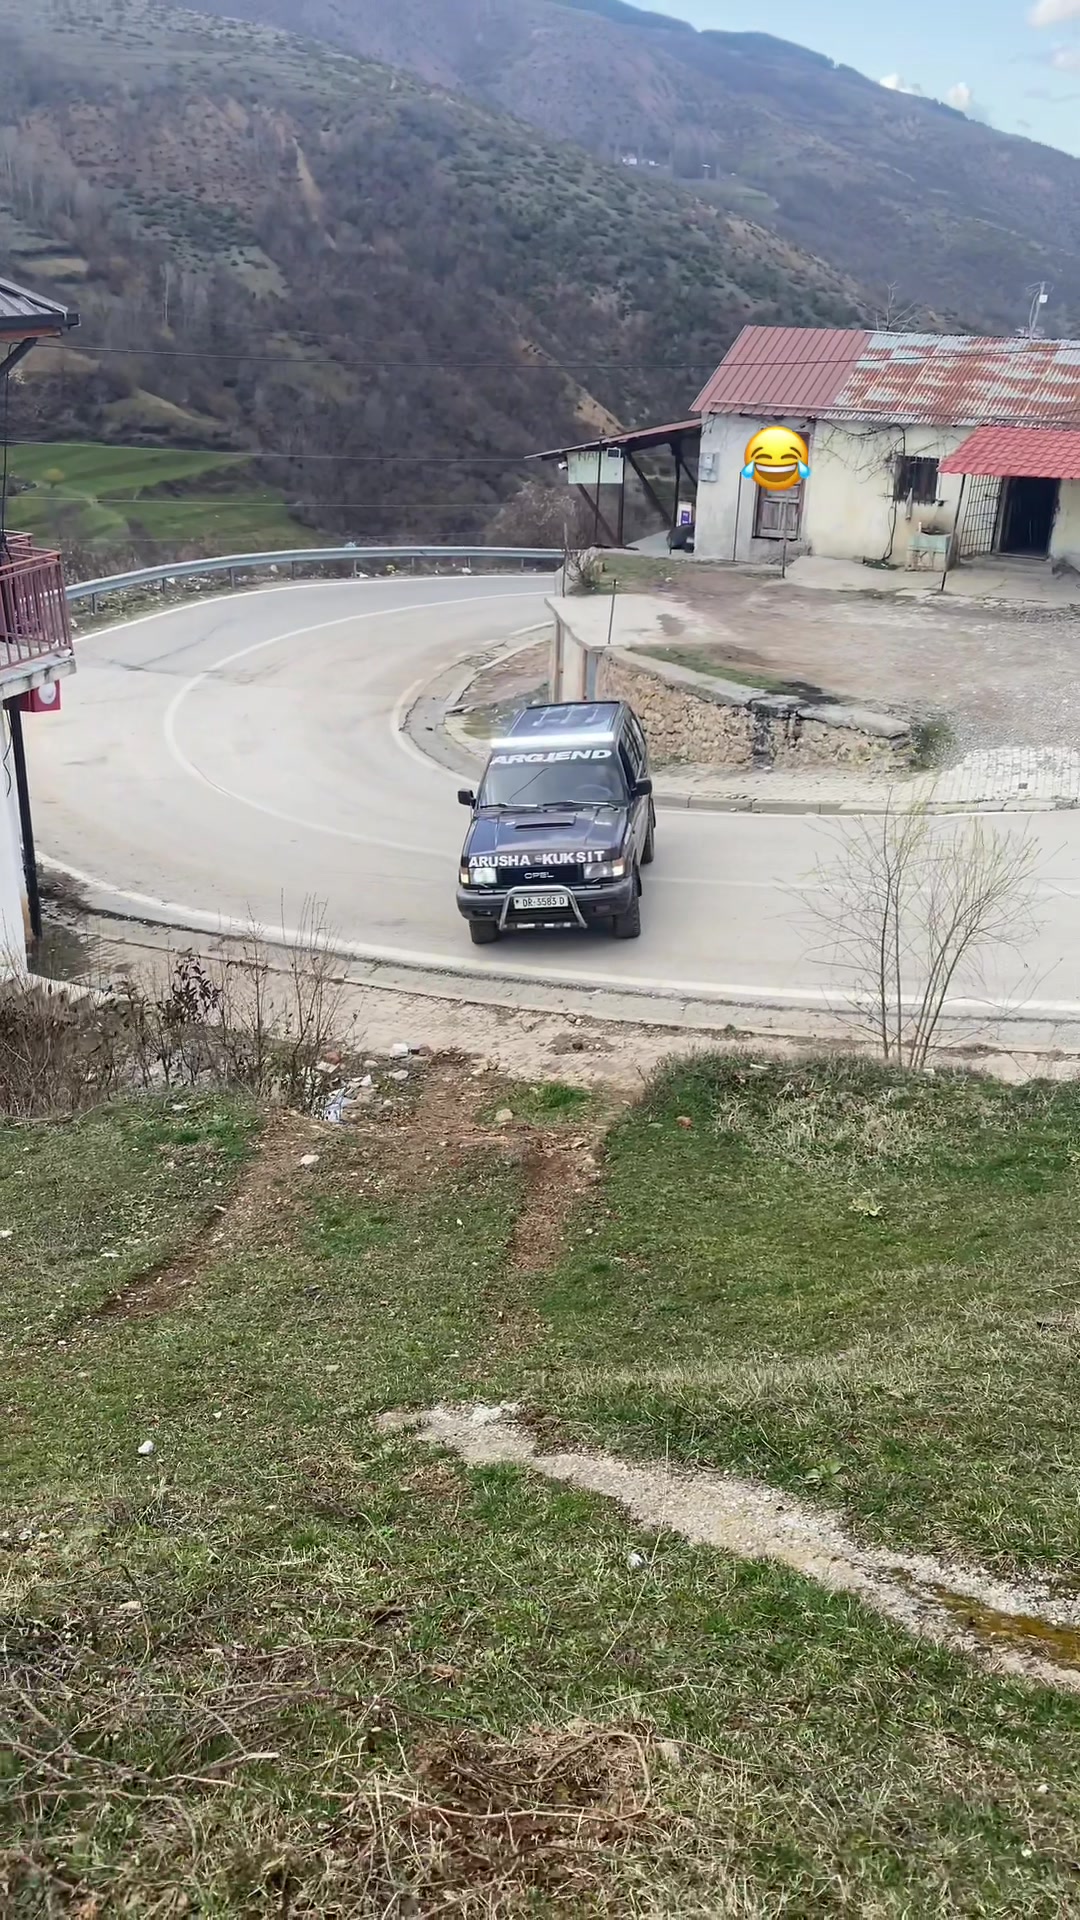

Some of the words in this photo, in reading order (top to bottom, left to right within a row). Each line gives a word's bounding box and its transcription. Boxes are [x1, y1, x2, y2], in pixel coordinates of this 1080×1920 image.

[490, 749, 612, 766] ARGJEND
[468, 854, 531, 868] ARUSHA
[542, 850, 605, 865] KUKSIT
[524, 871, 554, 879] OPEL
